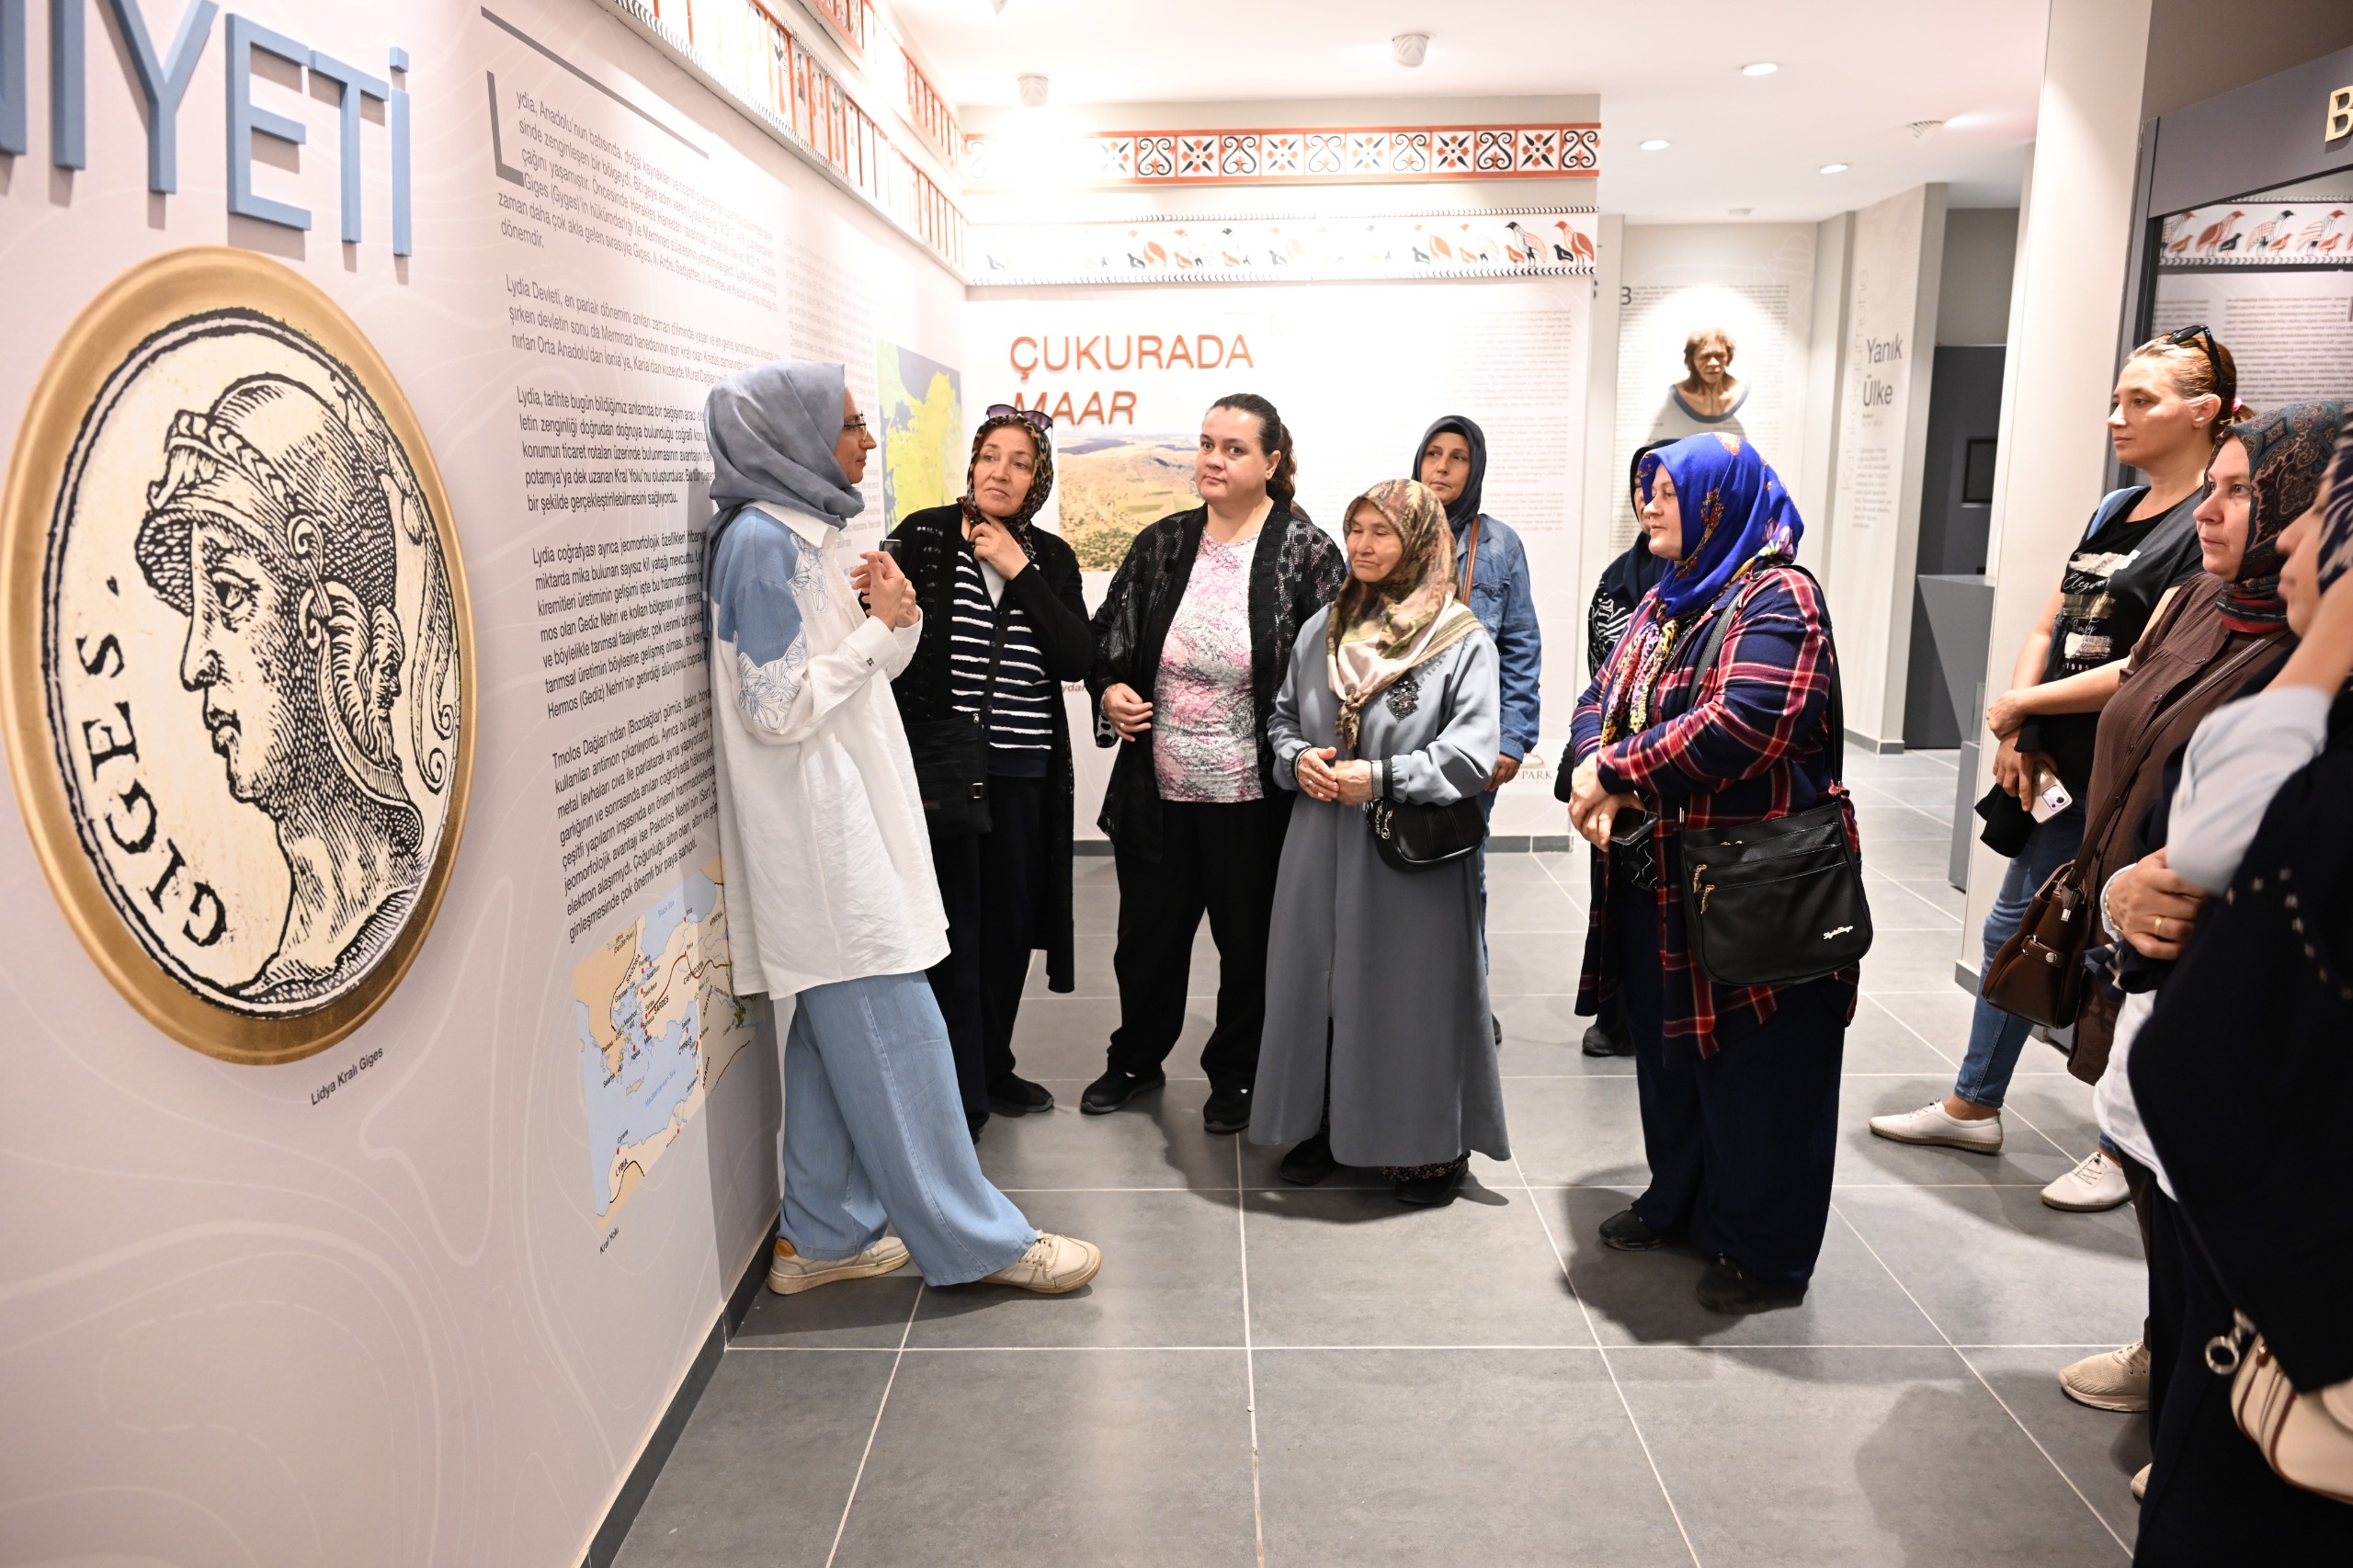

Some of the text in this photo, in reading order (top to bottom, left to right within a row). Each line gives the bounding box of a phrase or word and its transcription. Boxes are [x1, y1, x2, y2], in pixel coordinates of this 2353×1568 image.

[516, 91, 623, 160] ydia, Anadolu'nun batısında,
[518, 118, 601, 172] sinde zenginleşen bir
[521, 148, 590, 192] çağını yaşamıştır.
[524, 172, 589, 215] Giges (Gyges)'in
[497, 192, 605, 245] zaman daha çok akla gelen
[500, 218, 544, 249] dönemdir.
[506, 273, 631, 324] Lydia Devleti, en parlak dönemini
[508, 304, 633, 347] şırken devletin sonu da Mermnad
[511, 332, 633, 372] nırları Orta Anadolu'dan İonia'ya,
[1010, 334, 1254, 380] ÇUKURADA
[1866, 332, 1904, 366] Yanık
[517, 385, 654, 417] Lydia, tarihte bugün bildiğimiz anlamda
[1013, 391, 1137, 426] MAAR
[1862, 373, 1893, 407] Ülke
[519, 413, 642, 441] letin zenginliği doğrudan doğruya
[521, 440, 642, 460] konumun ticaret rotaları üzerinde
[525, 468, 652, 488] potamya'ya dek uzanan Kral Yolu'nu
[527, 490, 647, 515] bir şekilde gerçekleştirilebilmesini
[532, 534, 661, 568] Lydia coğrafyası ayrıca jeomorfolojik
[535, 556, 651, 591] miktarda mika bulunan sayısız kil
[537, 593, 576, 617] kiremitleri
[577, 586, 613, 608] üretiminin
[614, 581, 639, 604] gelişimi
[639, 580, 652, 597] işte
[540, 604, 648, 642] mos olan Gediz Nehri ve kolları
[542, 653, 553, 668] ve
[553, 641, 590, 665] böylelikle
[590, 631, 619, 654] tarımsal
[619, 625, 651, 646] faaliyetler,
[544, 669, 576, 694] tarımsal
[577, 660, 608, 683] üretimin
[608, 651, 640, 673] böylesine
[547, 664, 661, 720] Hermos (Gediz) Nehri'nin getirdiği
[551, 707, 662, 769] Tmolos Dağları'ndan (Bozdağlar)
[554, 732, 661, 795] kullanılan antimon çıkarılıyordu.
[557, 750, 665, 820] metal levhaları cıva ile parlatarak
[560, 778, 659, 845] garlığının ve sonrasında anılan
[562, 801, 655, 870] çeşitli yapıların inşasında en
[563, 828, 649, 896] jeomorfolojik avantajı ise
[567, 839, 666, 916] elektron alaşımıydı. Çoğunluğu
[569, 893, 620, 941] ginleşmesinde
[620, 882, 633, 904] çok
[633, 866, 654, 892] önemli
[626, 954, 642, 984] SKODRA
[654, 995, 669, 1016] SARDES
[311, 1047, 384, 1107] Lidya Kralı Giges
[599, 1227, 620, 1256] Kral Yolu
